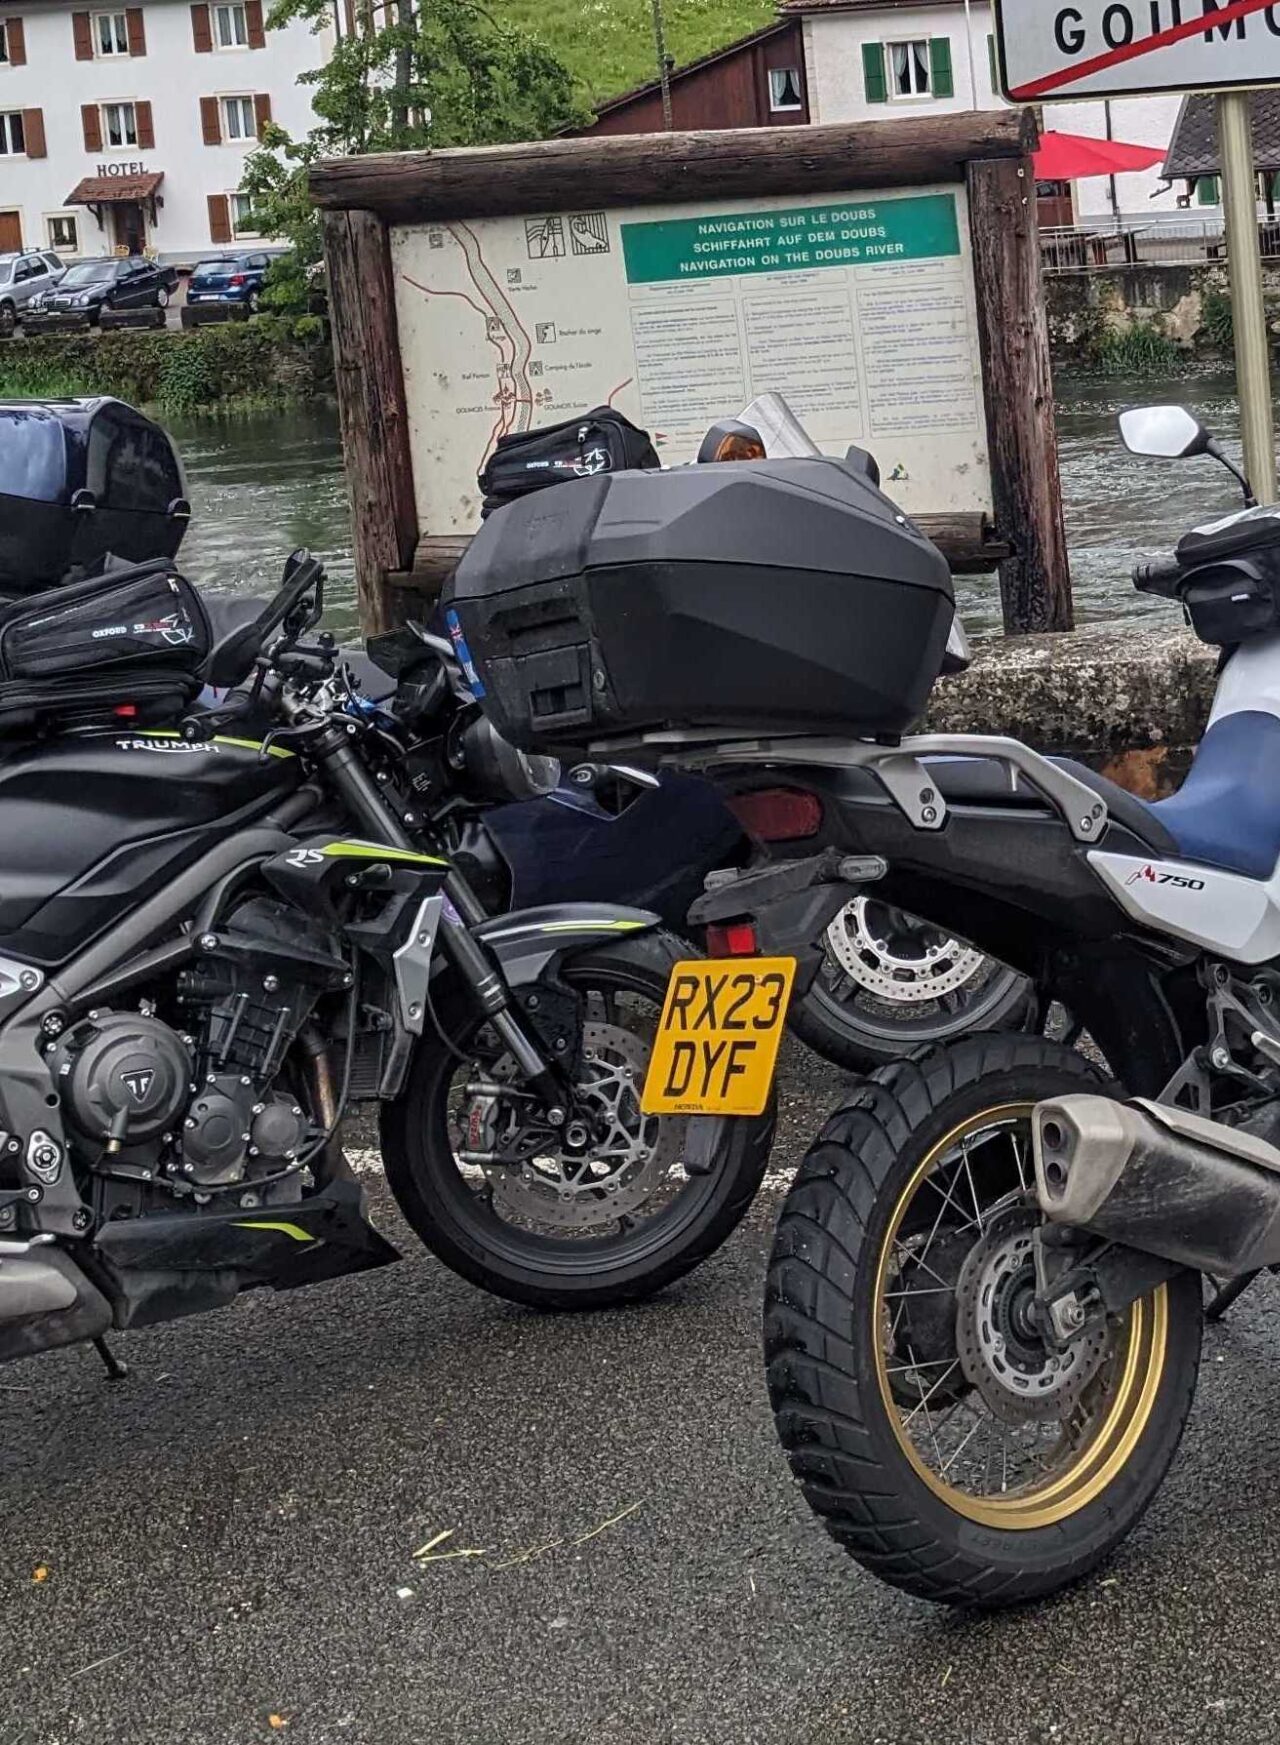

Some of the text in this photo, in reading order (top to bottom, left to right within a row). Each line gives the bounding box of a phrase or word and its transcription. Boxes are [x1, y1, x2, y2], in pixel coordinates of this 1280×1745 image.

[96, 162, 149, 177] HOTEL
[698, 209, 877, 235] NAVIGATION SUR LE DOUBS
[693, 227, 886, 253] SCHIFFAHRT AUF DEM DOUBS
[680, 243, 904, 272] NAVIGATION ON THE DOUBS RIVER
[91, 626, 127, 638] OXFORD
[115, 740, 220, 753] TRIUMPH
[285, 849, 324, 868] RS
[1158, 873, 1206, 891] 750
[664, 973, 786, 1031] RX23
[662, 1040, 757, 1098] DYF
